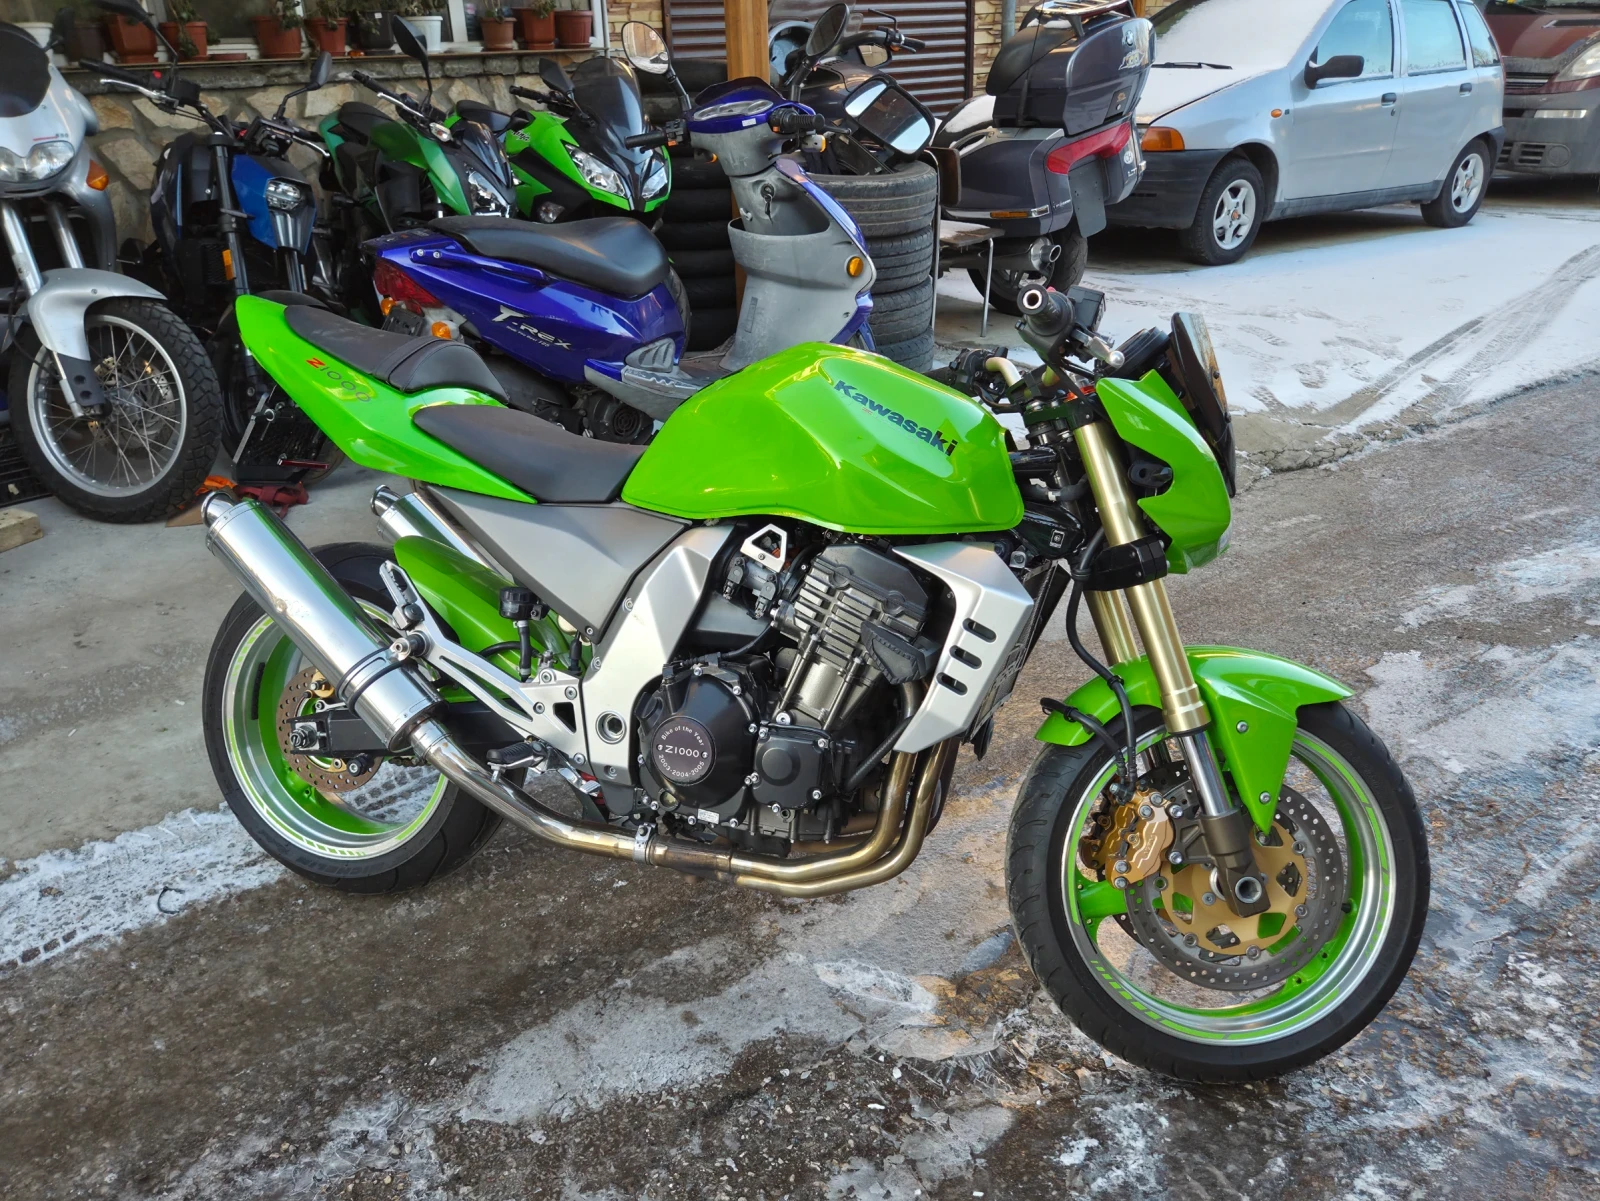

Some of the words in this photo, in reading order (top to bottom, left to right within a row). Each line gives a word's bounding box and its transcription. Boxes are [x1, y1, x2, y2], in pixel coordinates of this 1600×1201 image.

[306, 357, 371, 402] Z1000
[834, 380, 959, 457] Kawasaki
[661, 728, 674, 740] Bike
[682, 725, 693, 734] the
[693, 731, 705, 746] Year
[665, 744, 700, 758] Z1000
